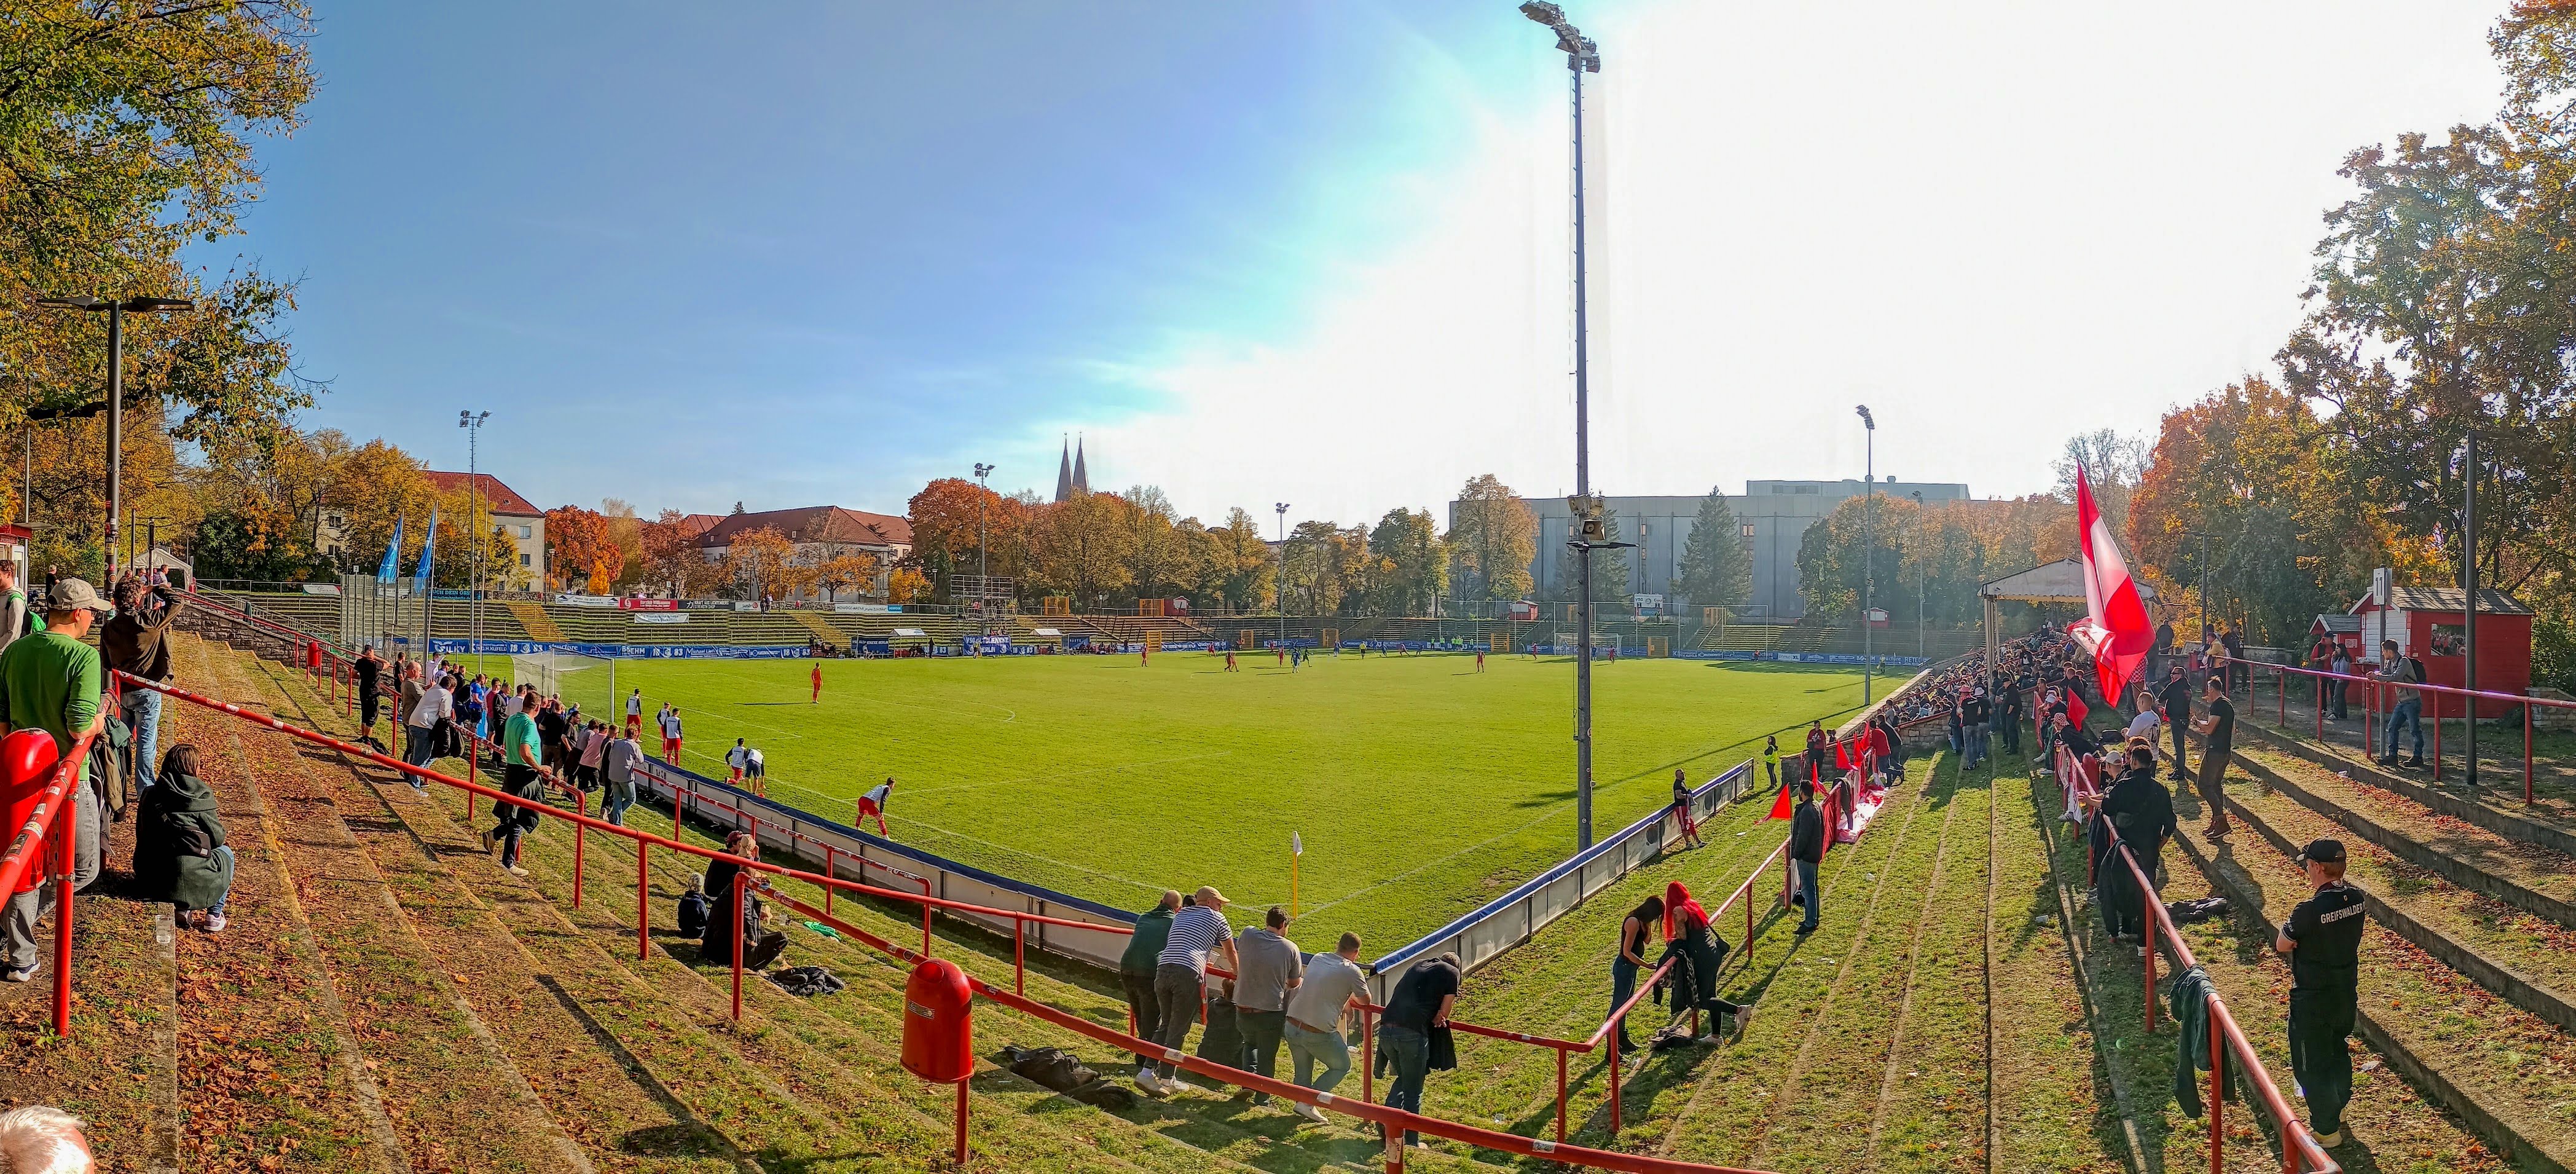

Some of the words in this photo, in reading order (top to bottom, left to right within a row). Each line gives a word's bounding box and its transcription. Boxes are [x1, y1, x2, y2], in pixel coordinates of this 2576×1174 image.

[2375, 577, 2382, 596] 11
[509, 644, 518, 652] 18
[673, 648, 683, 656] 83
[2320, 903, 2363, 924] GREIFSWALDER
